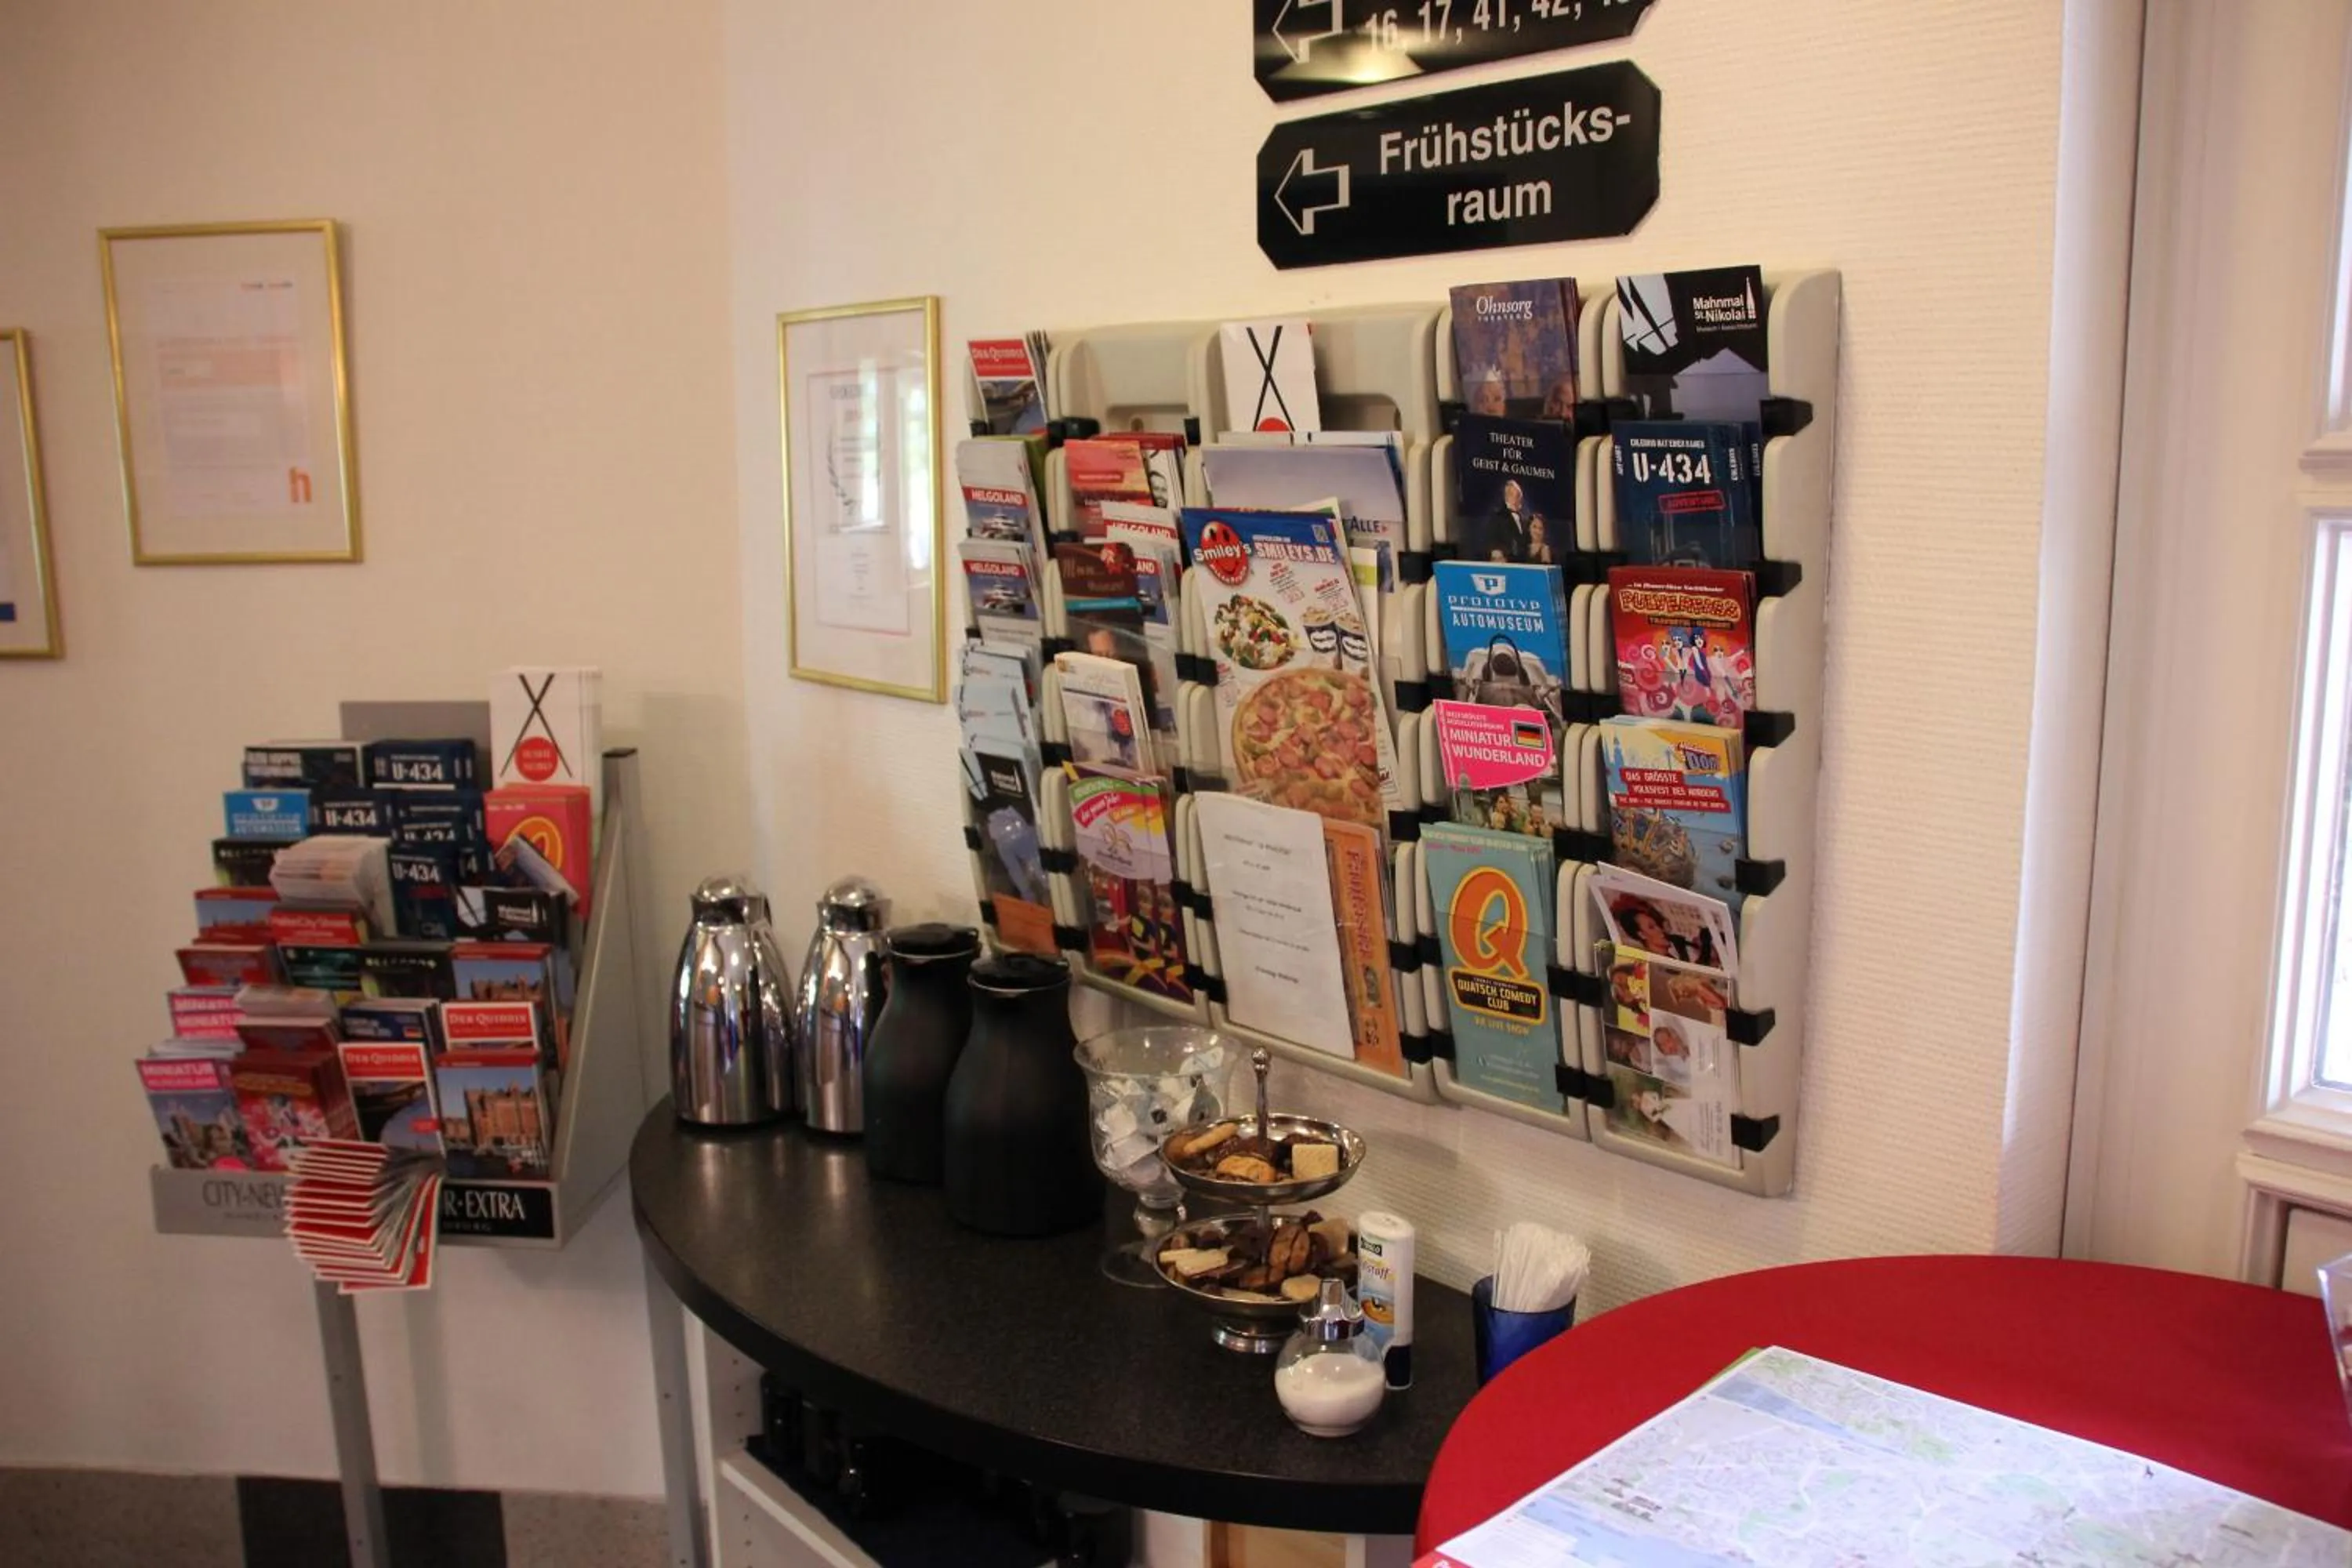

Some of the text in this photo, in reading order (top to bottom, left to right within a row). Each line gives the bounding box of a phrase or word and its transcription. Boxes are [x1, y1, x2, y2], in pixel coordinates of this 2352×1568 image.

[1418, 0, 1463, 45] 17,
[1380, 102, 1631, 176] Frühstücks-
[1447, 180, 1552, 226] raum
[1475, 295, 1534, 320] Ohnsorg
[1693, 293, 1744, 310] Mahnmal
[1705, 307, 1746, 323] Nikolai
[1488, 432, 1534, 449] THEATER
[1503, 447, 1523, 460] FÜR
[1472, 457, 1555, 480] GEIST & GAUMEN
[1632, 452, 1712, 485] U-434
[971, 488, 1023, 505] HELGOLAND
[1193, 539, 1252, 562] Smiley's
[1453, 612, 1544, 634] AUTOMUSEUM
[1450, 728, 1512, 748] MINIATUR
[1451, 743, 1546, 768] WUNDERLAND
[392, 762, 444, 781] U-434
[1625, 771, 1641, 782] DAS
[1457, 978, 1537, 1007] QUATSCH COMEDY
[1487, 996, 1510, 1011] CLUB
